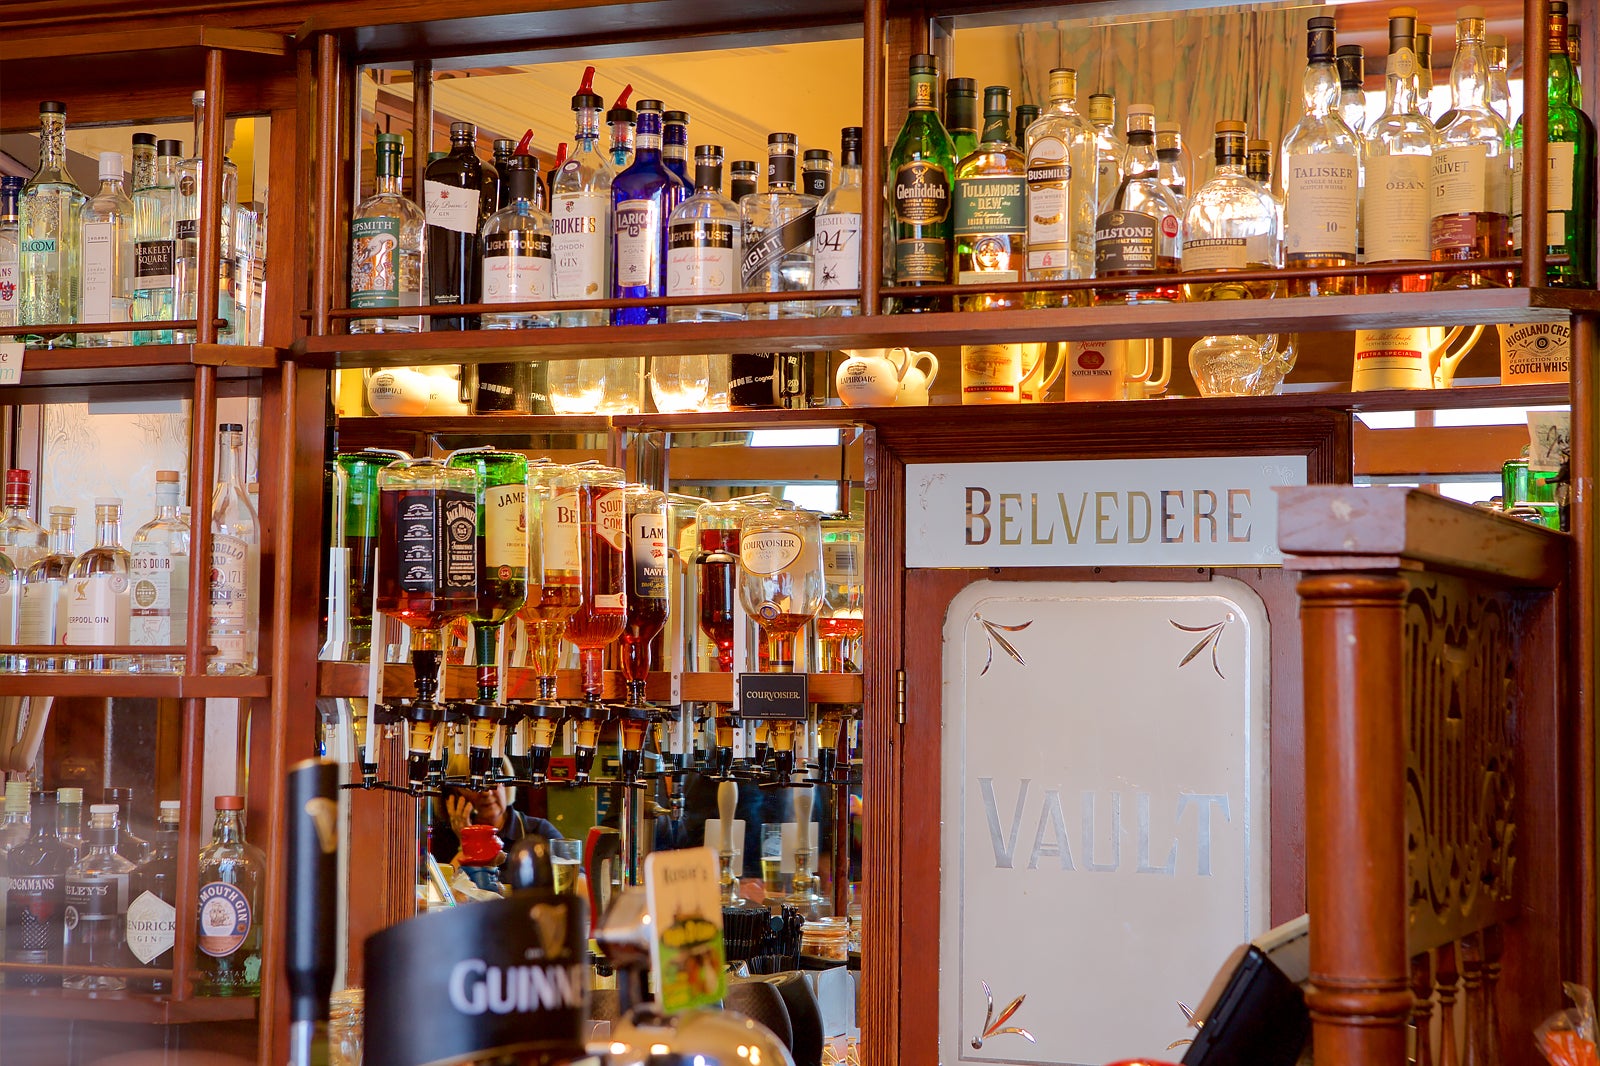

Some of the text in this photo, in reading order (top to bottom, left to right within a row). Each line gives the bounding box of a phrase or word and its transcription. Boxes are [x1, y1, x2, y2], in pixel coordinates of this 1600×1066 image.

[1028, 168, 1070, 181] BUSHMILLS
[1294, 167, 1353, 179] TALISKER
[896, 183, 946, 200] Glenfiddich
[961, 182, 1020, 198] TULLAMORE
[1385, 182, 1426, 191] OBAN
[1435, 185, 1446, 197] 15
[629, 226, 639, 236] 12
[1325, 221, 1338, 233] 10
[22, 240, 55, 252] BLOOM
[486, 239, 549, 252] LIGHTHOUSE
[554, 243, 585, 251] LONDON
[914, 242, 925, 252] 12
[1122, 245, 1153, 254] MALT
[1191, 239, 1244, 248] GLENROTHES
[135, 245, 171, 255] BERKELEY
[138, 254, 168, 265] SQUARE
[560, 257, 578, 267] GIN
[1505, 324, 1549, 348] HIGHLAND
[1509, 361, 1570, 375] SCOTCH WHIS
[964, 486, 1253, 546] BELVEDERE
[743, 539, 795, 551] COURVOISIER
[149, 558, 170, 569] DOOR
[94, 616, 110, 624] GIN
[746, 690, 801, 702] COURVOISIER
[976, 777, 1232, 878] VAULT
[234, 900, 248, 922] GIN
[136, 935, 158, 944] GIN
